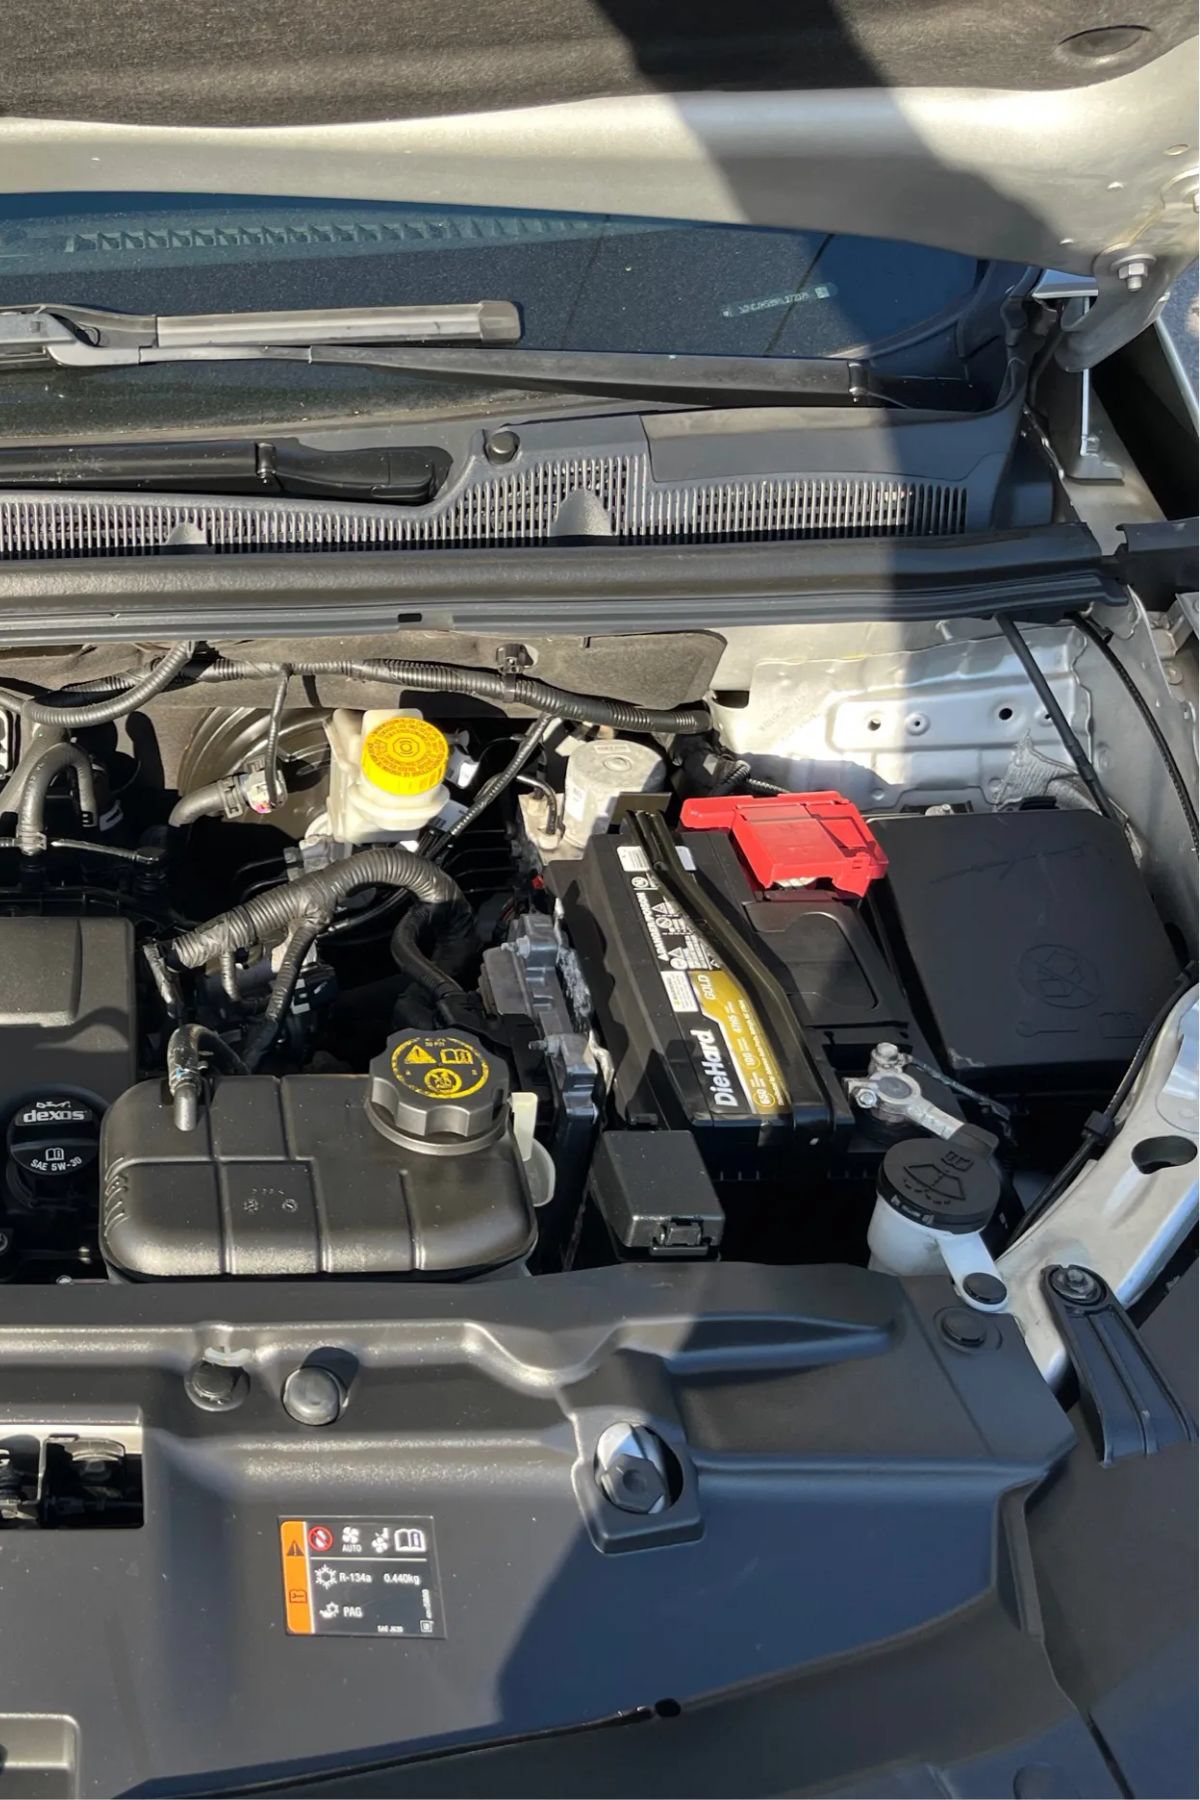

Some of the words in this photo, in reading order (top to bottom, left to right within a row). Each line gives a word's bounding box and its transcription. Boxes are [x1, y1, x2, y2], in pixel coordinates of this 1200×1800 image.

[697, 975, 716, 1000] GOLD
[690, 1029, 738, 1107] DieHard
[23, 1110, 85, 1123] dexos
[30, 1159, 48, 1171] SAE
[51, 1156, 83, 1171] 5W-30
[342, 1544, 362, 1553] AUTO
[339, 1572, 372, 1584] R-134a
[383, 1573, 420, 1586] 0.440kg
[343, 1606, 363, 1618] PAG
